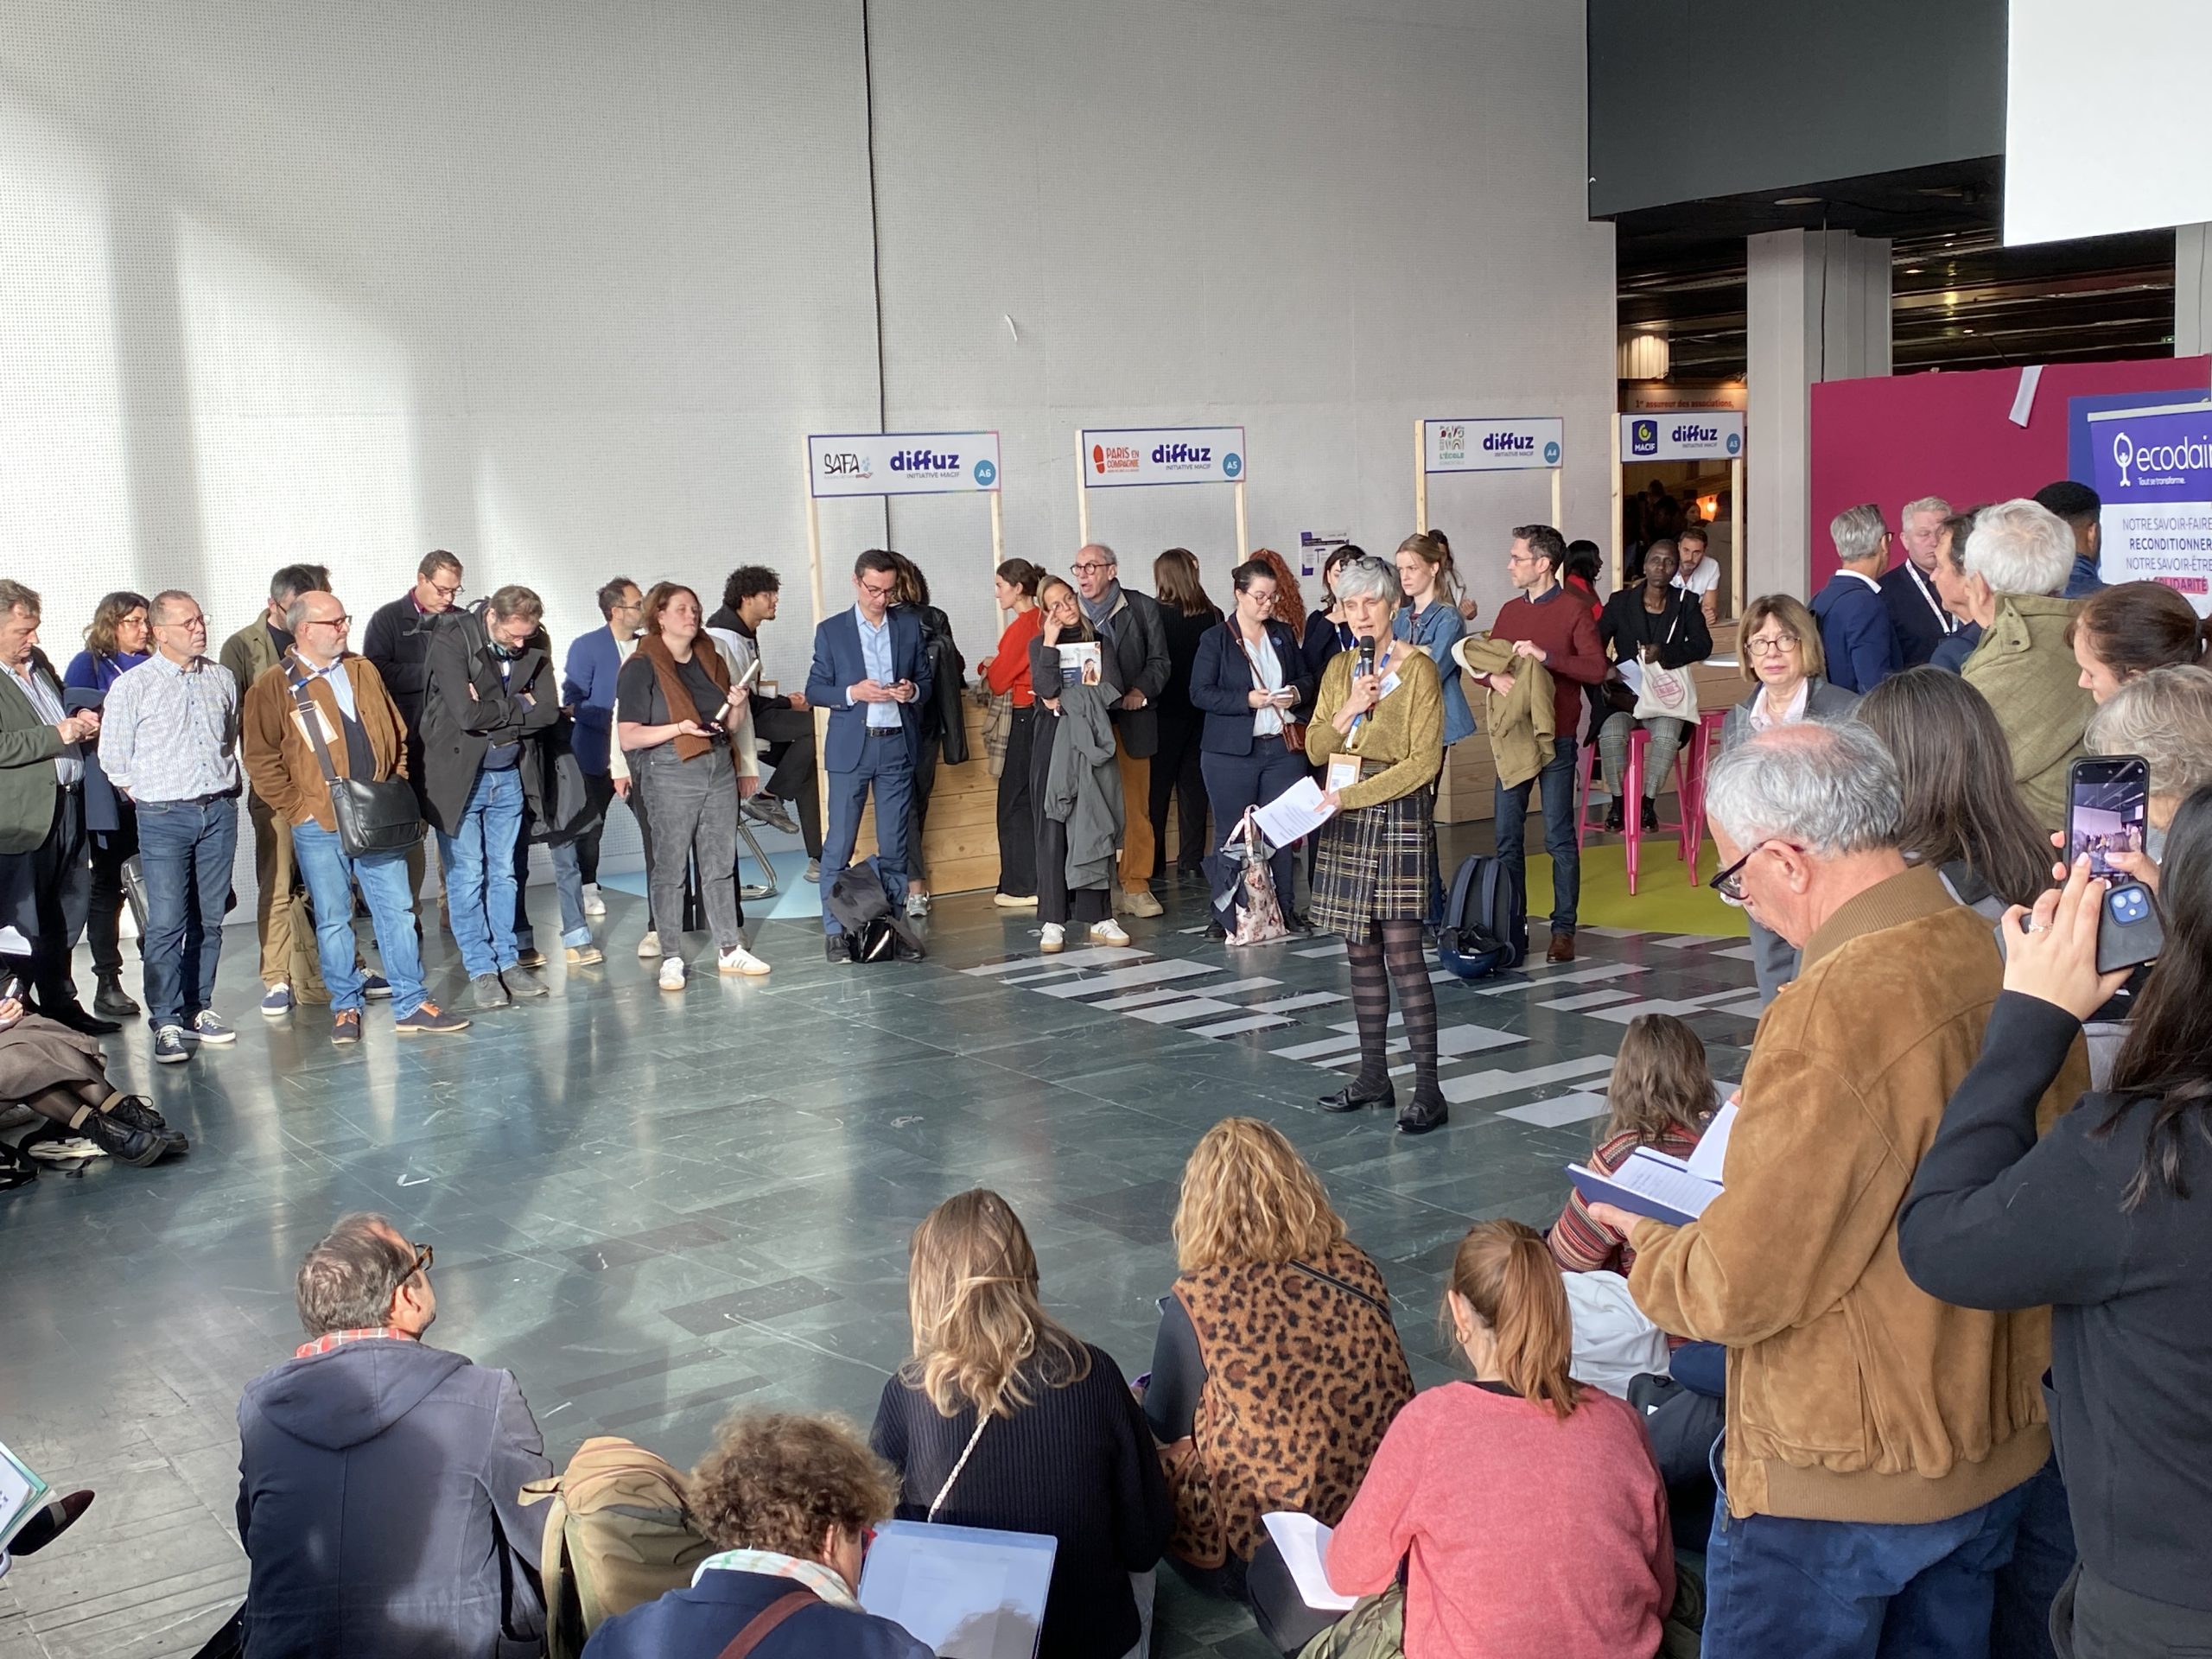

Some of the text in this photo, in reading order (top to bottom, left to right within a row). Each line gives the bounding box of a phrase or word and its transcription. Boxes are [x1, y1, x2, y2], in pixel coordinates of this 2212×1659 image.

[1672, 425, 1718, 442] diffuz
[1483, 433, 1534, 450] diffuz
[1635, 442, 1656, 451] MACIF
[1106, 447, 1140, 459] PARIS EN
[1152, 443, 1211, 463] diffuz
[824, 454, 860, 474] SAFA
[890, 450, 960, 471] diffuz
[1227, 461, 1237, 470] A5
[978, 468, 992, 478] A6
[2122, 518, 2212, 531] NOTRE SAVOIR-FAIRE
[2130, 537, 2212, 550] RECONDITIONNER
[2126, 555, 2212, 571] NOTRE SAVOIR-ÊTRE
